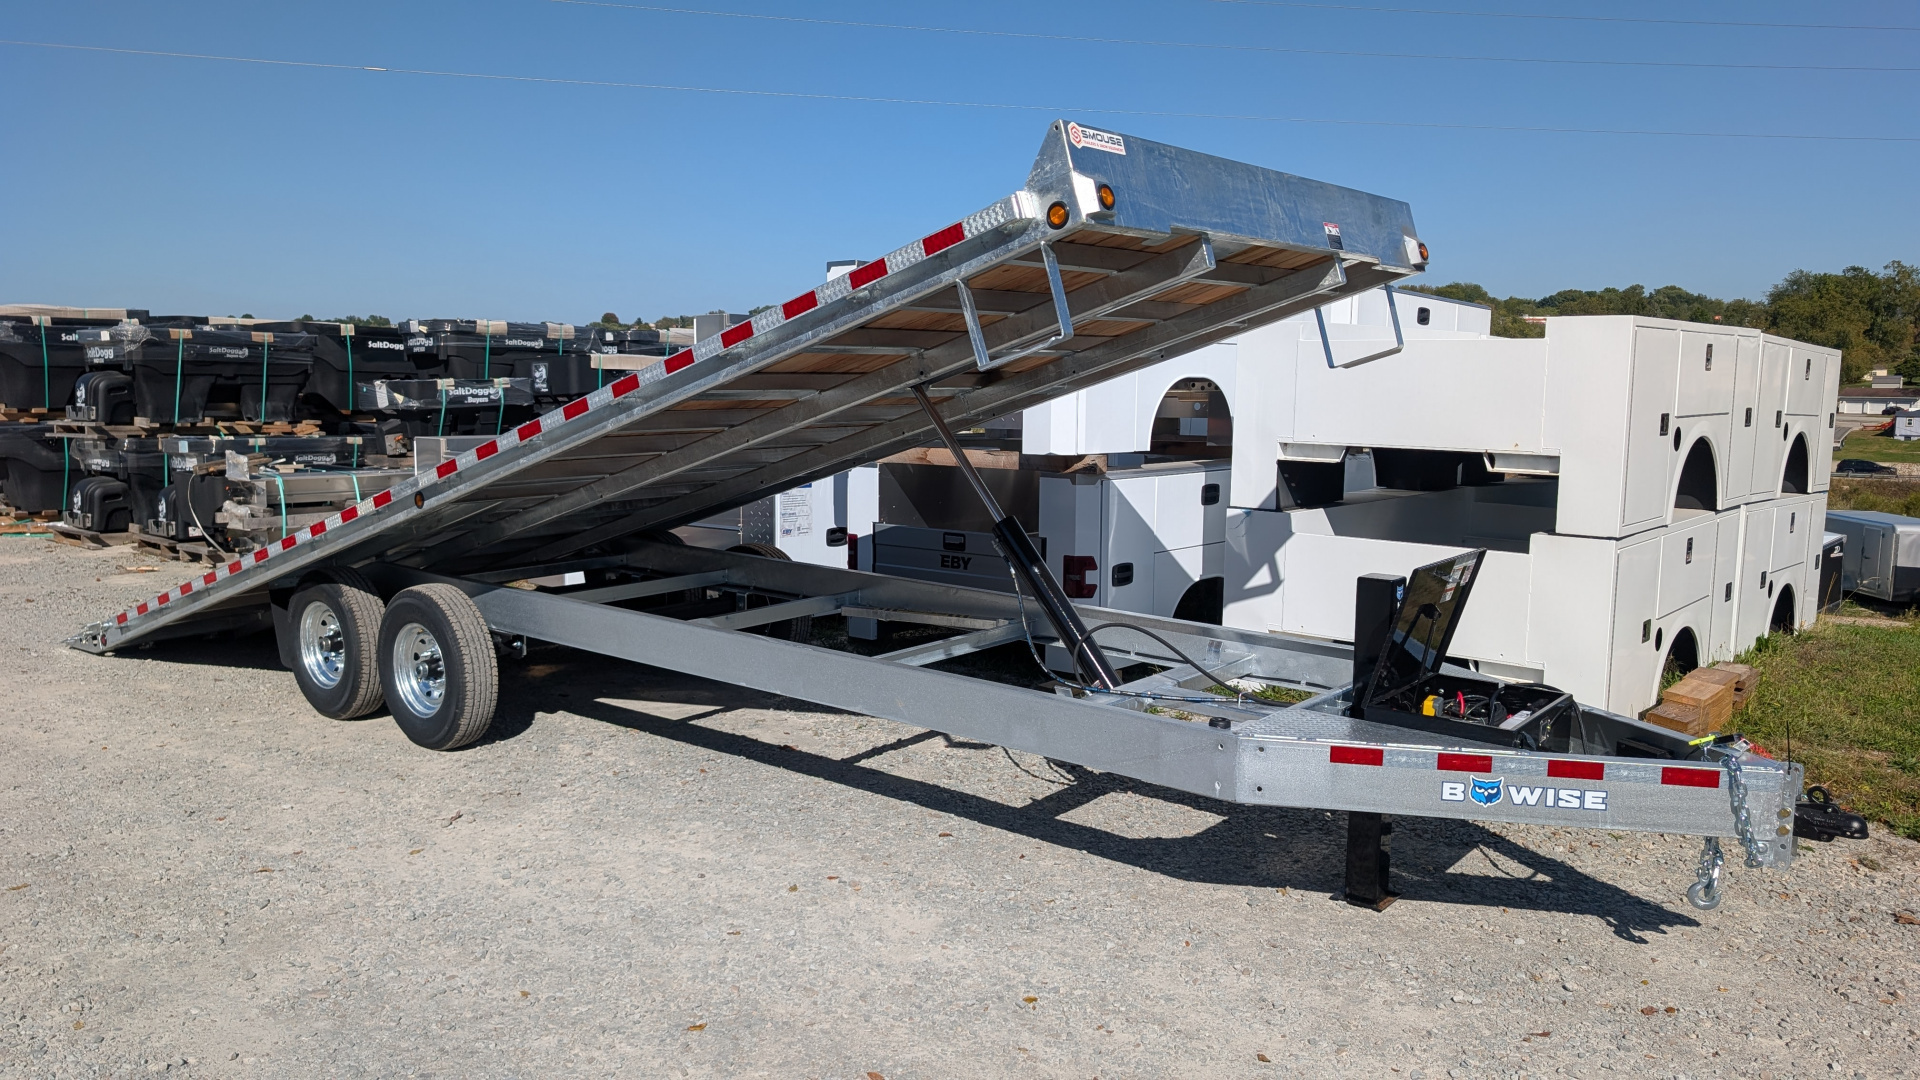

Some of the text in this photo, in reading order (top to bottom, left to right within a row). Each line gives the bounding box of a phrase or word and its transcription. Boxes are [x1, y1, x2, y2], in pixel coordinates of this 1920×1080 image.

[1081, 130, 1122, 146] SMOUSE
[368, 341, 404, 350] SaltDogg
[505, 339, 536, 347] SaltDogg
[449, 387, 489, 396] SaltDogg
[940, 554, 972, 570] EBY
[1507, 785, 1607, 811] WISE
